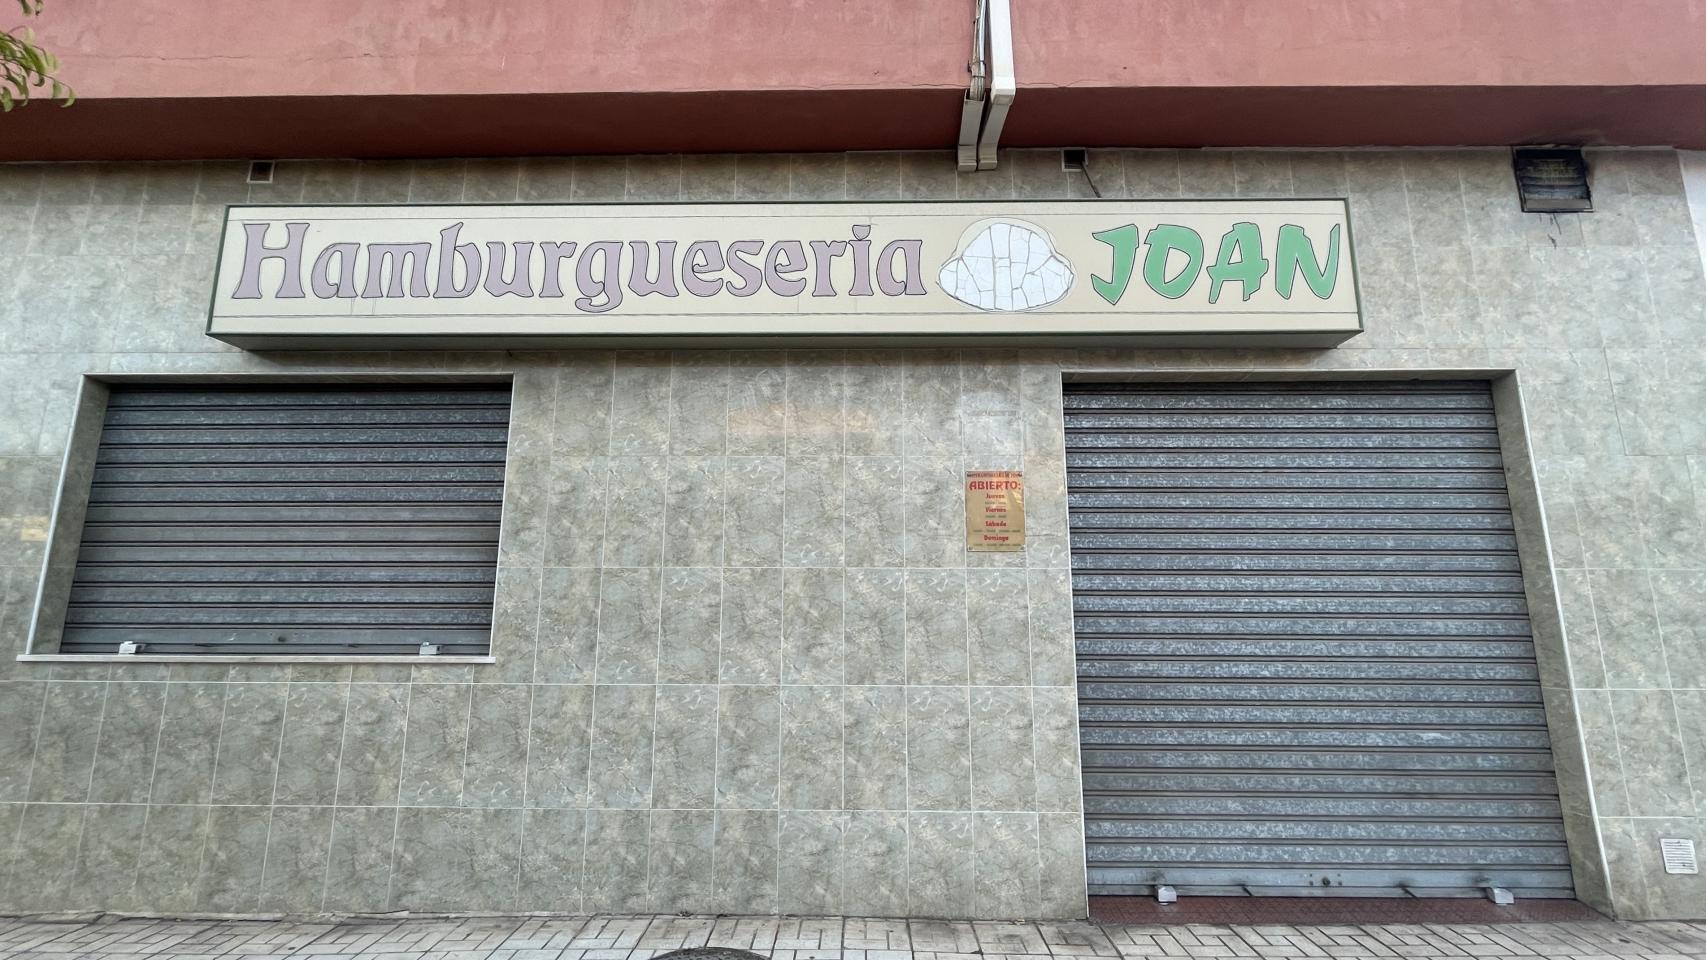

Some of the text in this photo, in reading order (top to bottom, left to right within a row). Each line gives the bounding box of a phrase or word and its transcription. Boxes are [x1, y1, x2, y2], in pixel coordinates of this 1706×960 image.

[232, 222, 1340, 313] Hamburgueseria JOAN
[969, 481, 1021, 490] ABIERTO:
